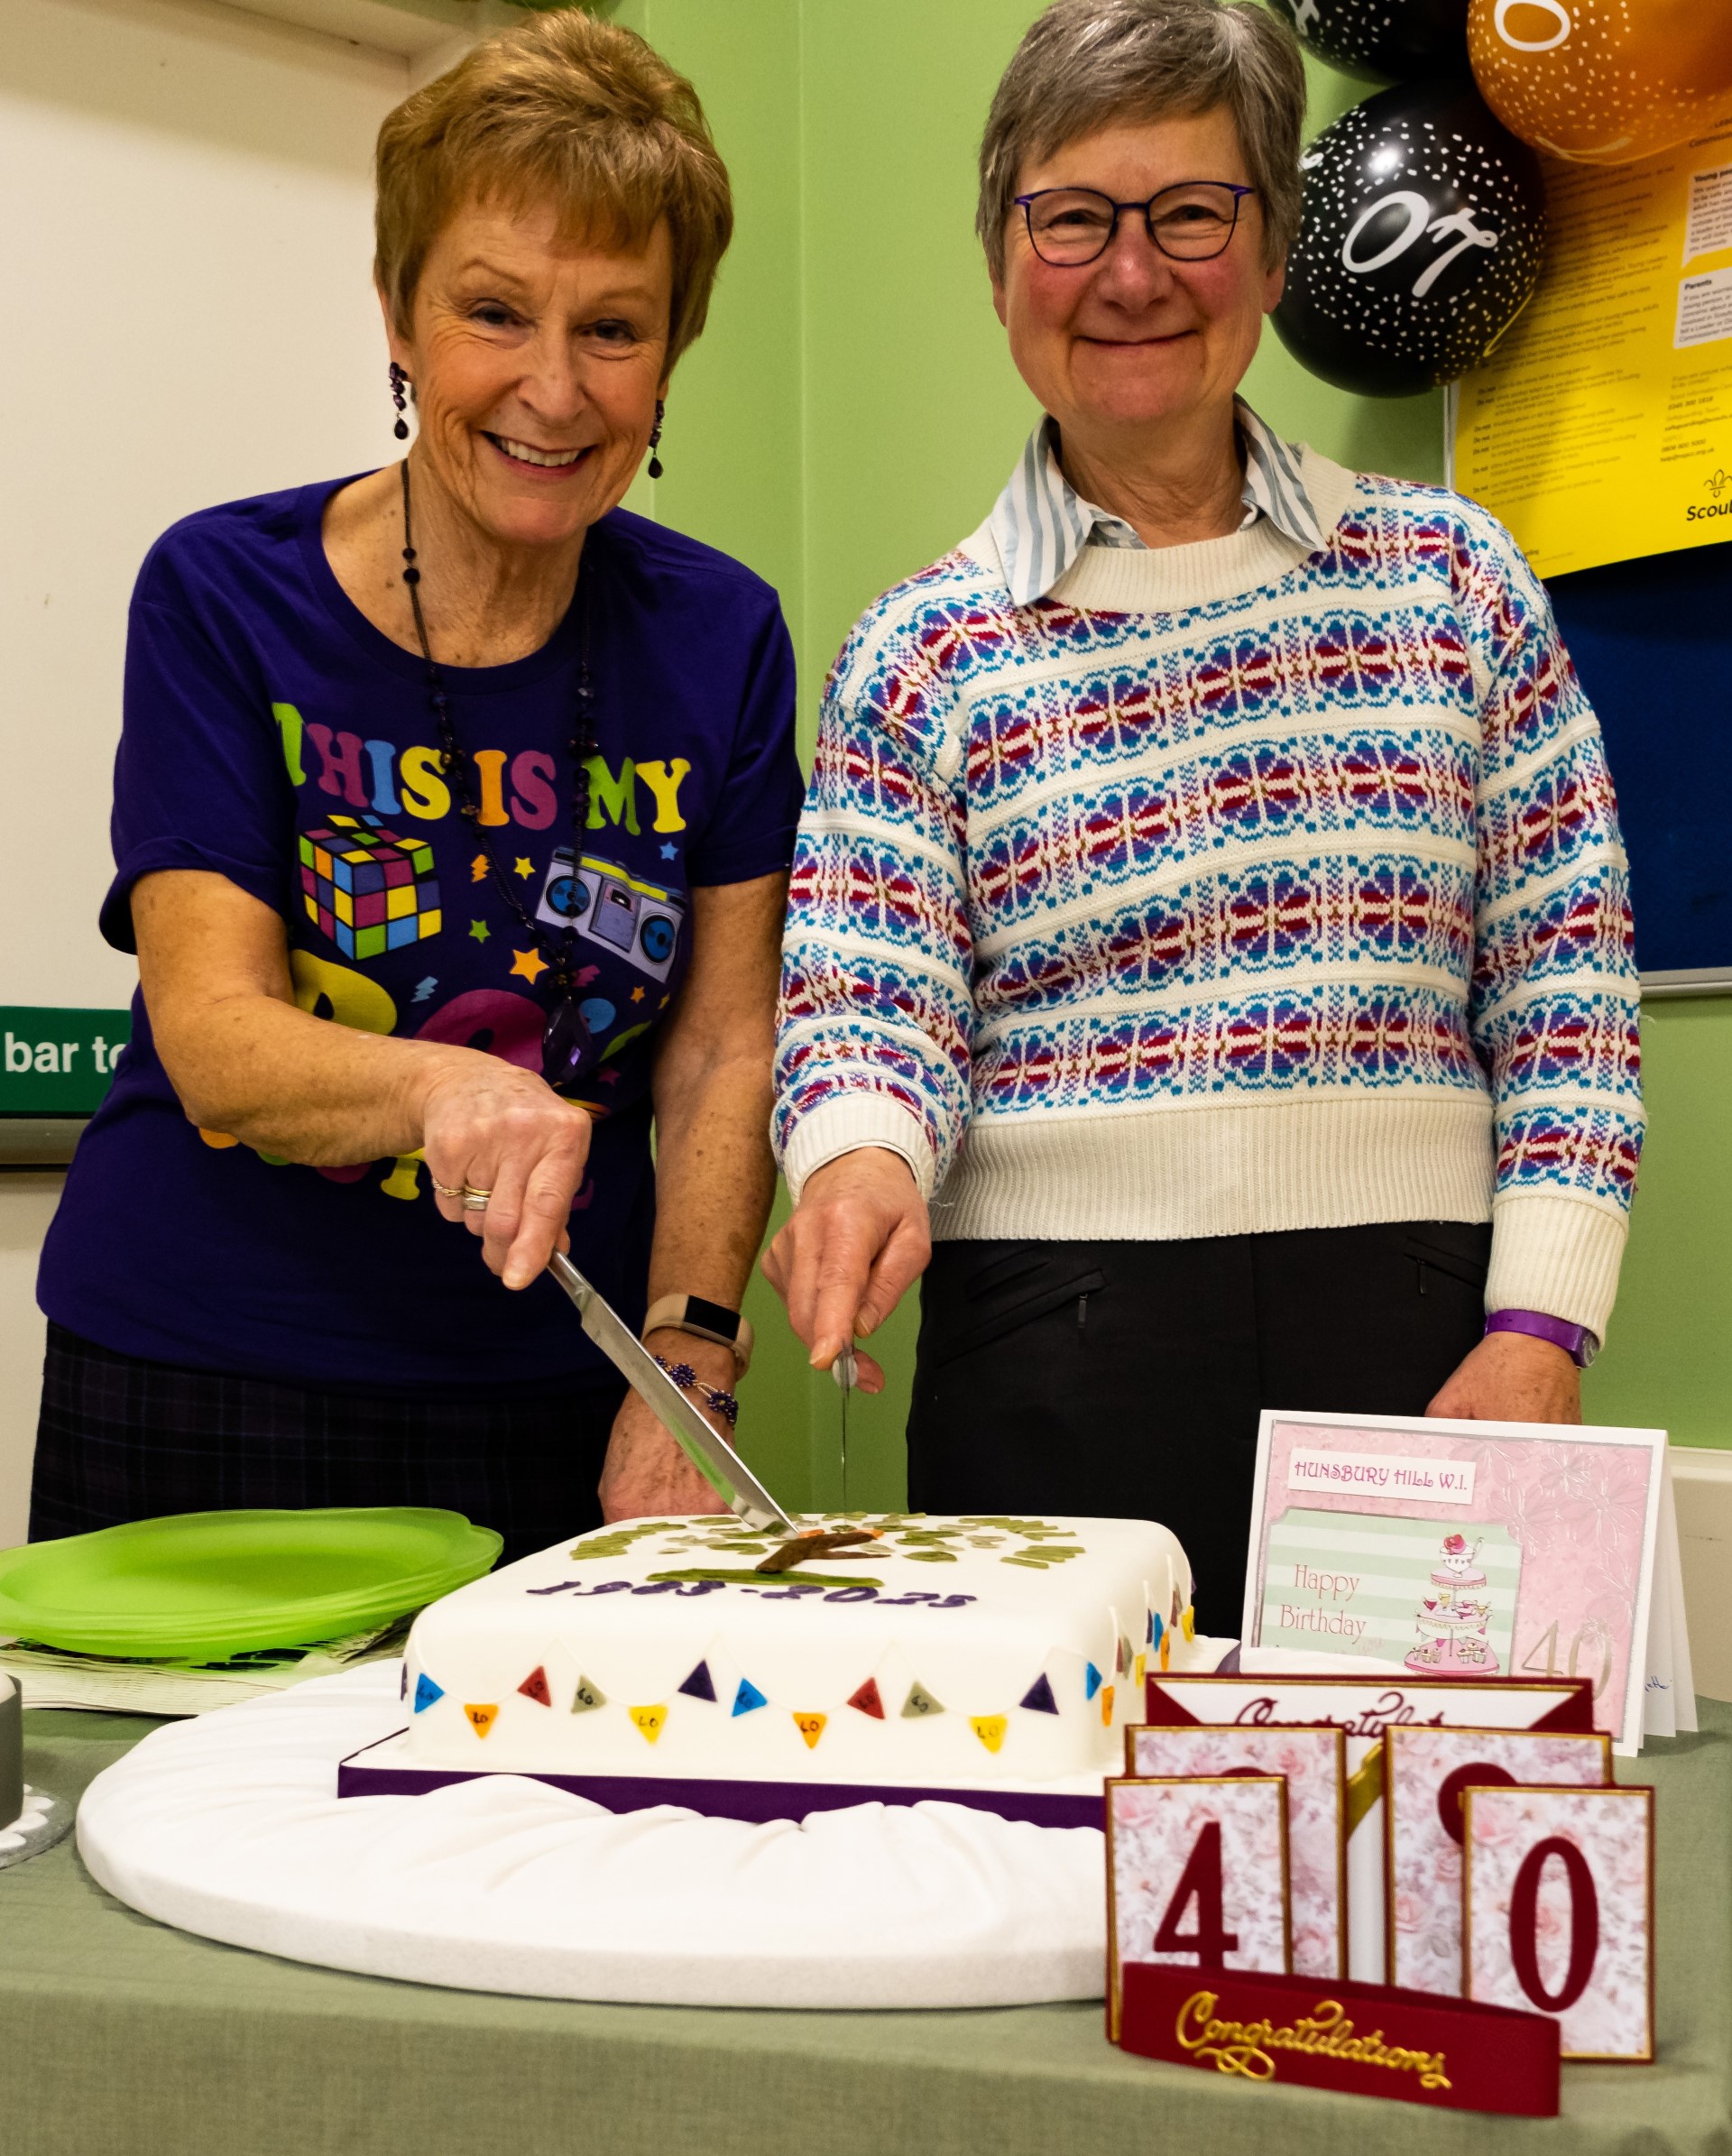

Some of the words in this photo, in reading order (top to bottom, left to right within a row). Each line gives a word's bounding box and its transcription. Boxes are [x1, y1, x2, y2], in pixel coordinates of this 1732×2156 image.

[1684, 280, 1712, 290] Parents
[473, 749, 558, 831] IS
[581, 755, 692, 836] MY
[5, 1031, 79, 1073] bar
[1295, 1460, 1390, 1487] HUNSBURY
[1394, 1470, 1433, 1488] HILL
[1294, 1563, 1359, 1602] Happy
[1280, 1603, 1367, 1645] Birthday
[1153, 1820, 1239, 1970] 4
[1509, 1835, 1598, 2013] 0
[1175, 1990, 1453, 2089] Congratulations
